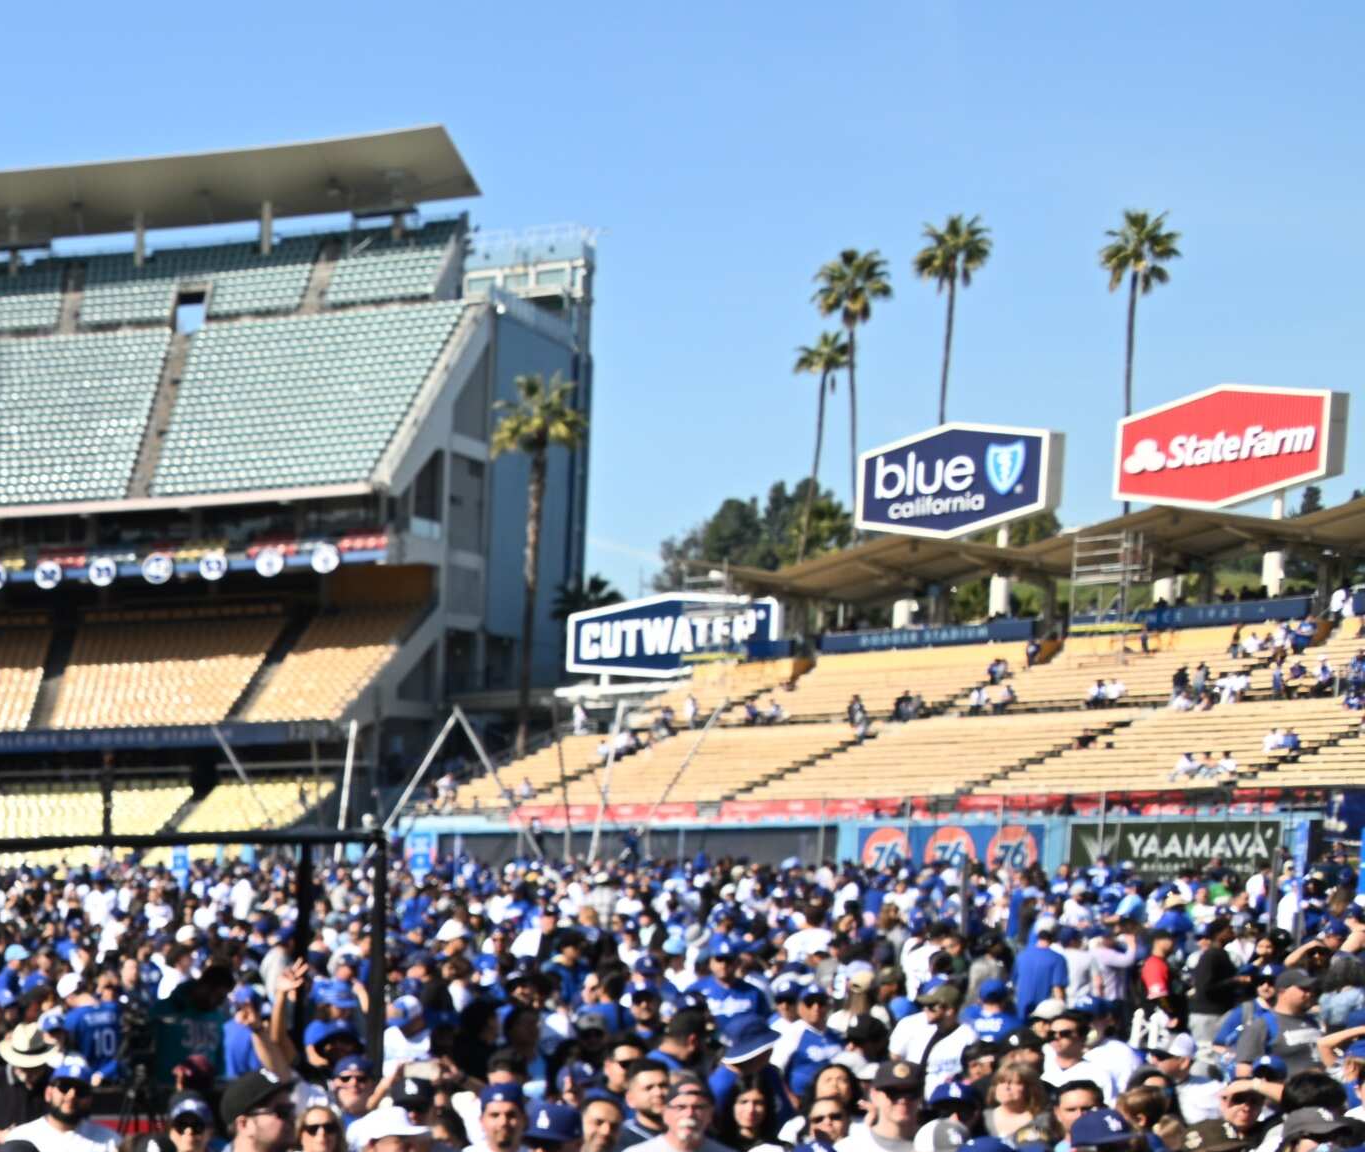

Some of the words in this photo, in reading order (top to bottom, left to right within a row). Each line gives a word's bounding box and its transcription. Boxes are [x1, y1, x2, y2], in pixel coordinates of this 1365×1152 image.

[874, 450, 976, 499] blue
[888, 491, 986, 519] california
[873, 841, 904, 869] 76
[936, 841, 965, 868] 76
[996, 841, 1026, 869] 76
[94, 1029, 116, 1056] 10
